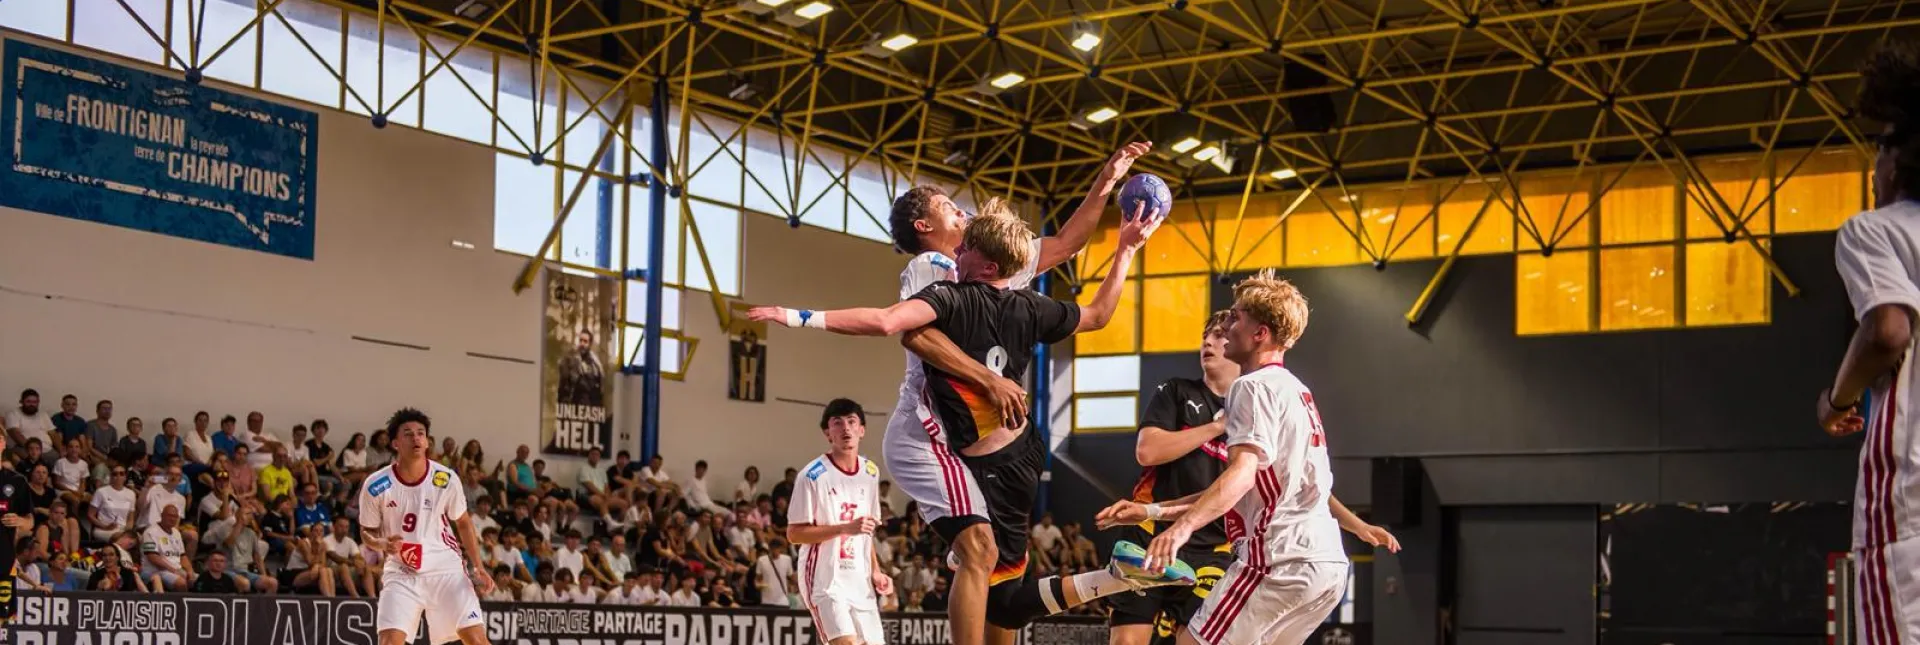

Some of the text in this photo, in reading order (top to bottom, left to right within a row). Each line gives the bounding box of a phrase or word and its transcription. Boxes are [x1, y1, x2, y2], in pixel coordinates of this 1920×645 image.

[66, 93, 186, 149] FRONTIGNAN
[168, 151, 291, 202] CHAMPIONS
[556, 403, 606, 424] UNLEASH
[554, 420, 605, 450] HELL
[401, 512, 418, 533] 9
[9, 596, 70, 626] ISIR
[77, 598, 178, 631] PLAISIR
[593, 611, 664, 634] PARTAGE
[901, 618, 954, 645] PARTA
